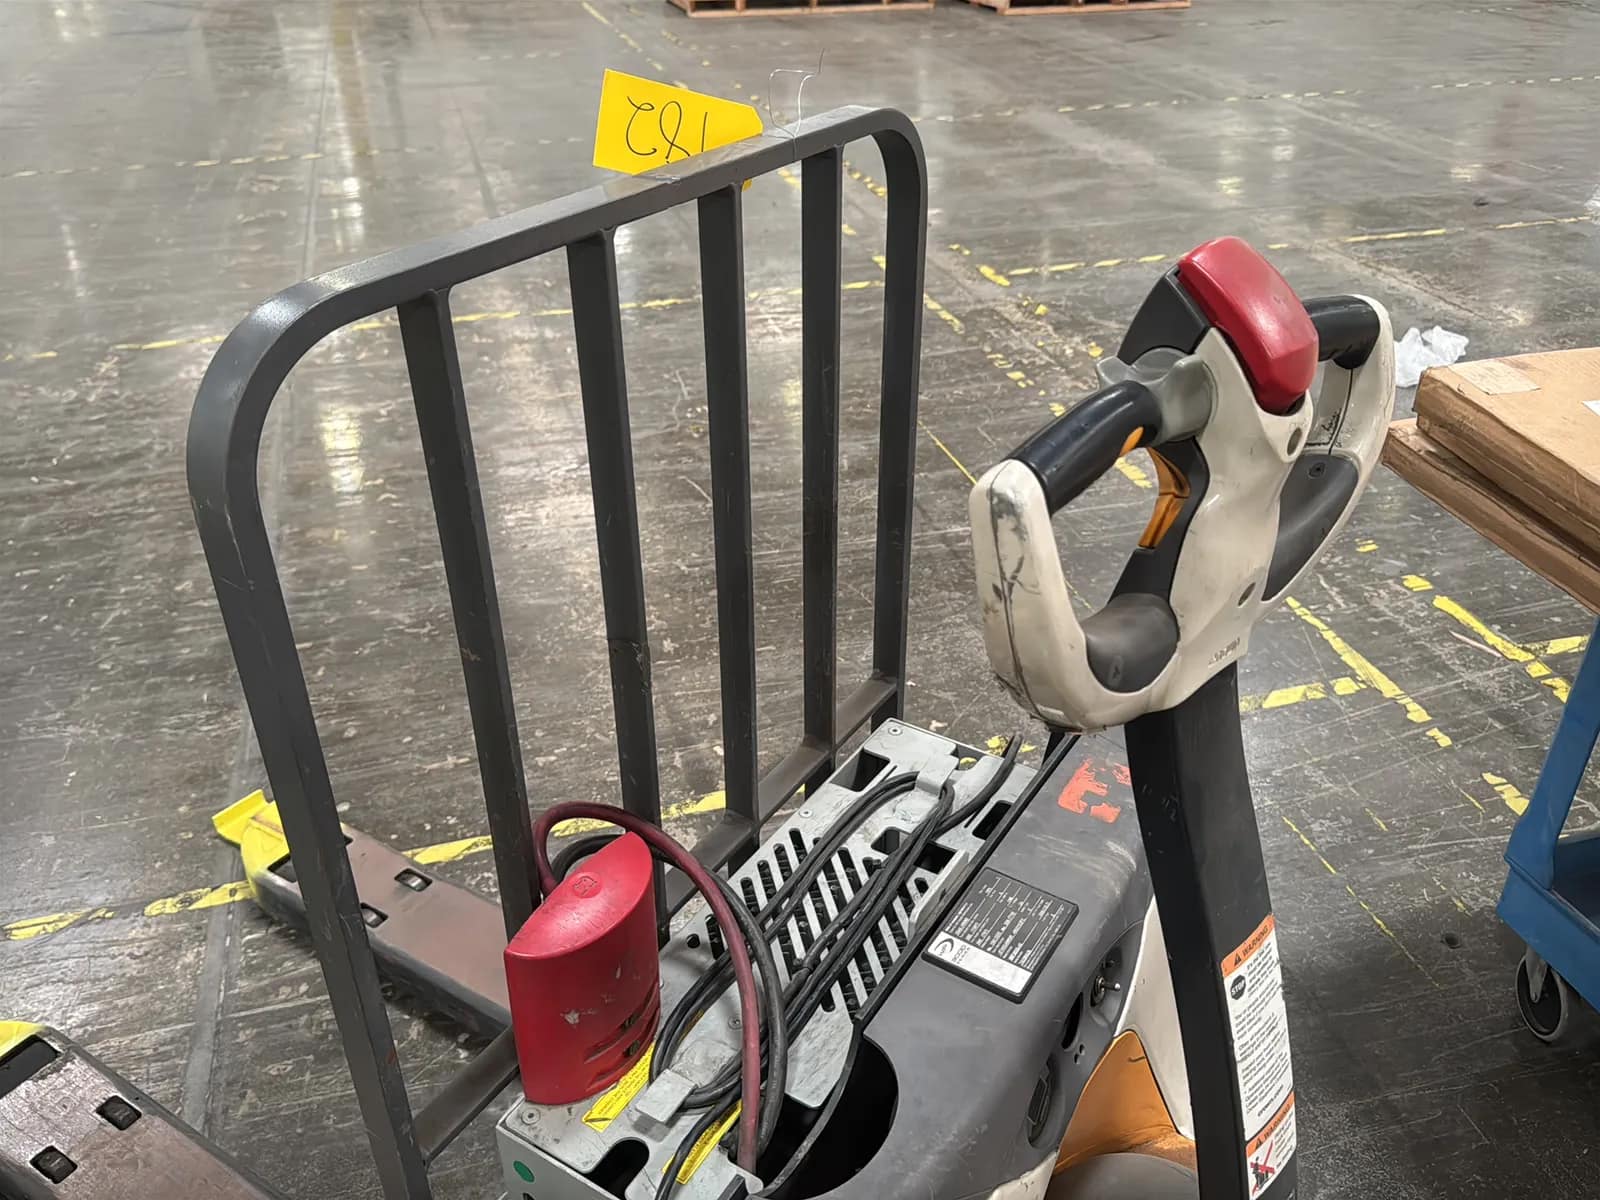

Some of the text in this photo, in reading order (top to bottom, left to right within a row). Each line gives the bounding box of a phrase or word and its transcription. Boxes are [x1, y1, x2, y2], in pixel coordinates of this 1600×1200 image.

[626, 96, 708, 163] 182
[1242, 925, 1269, 956] WARNING
[1231, 979, 1246, 995] STOP
